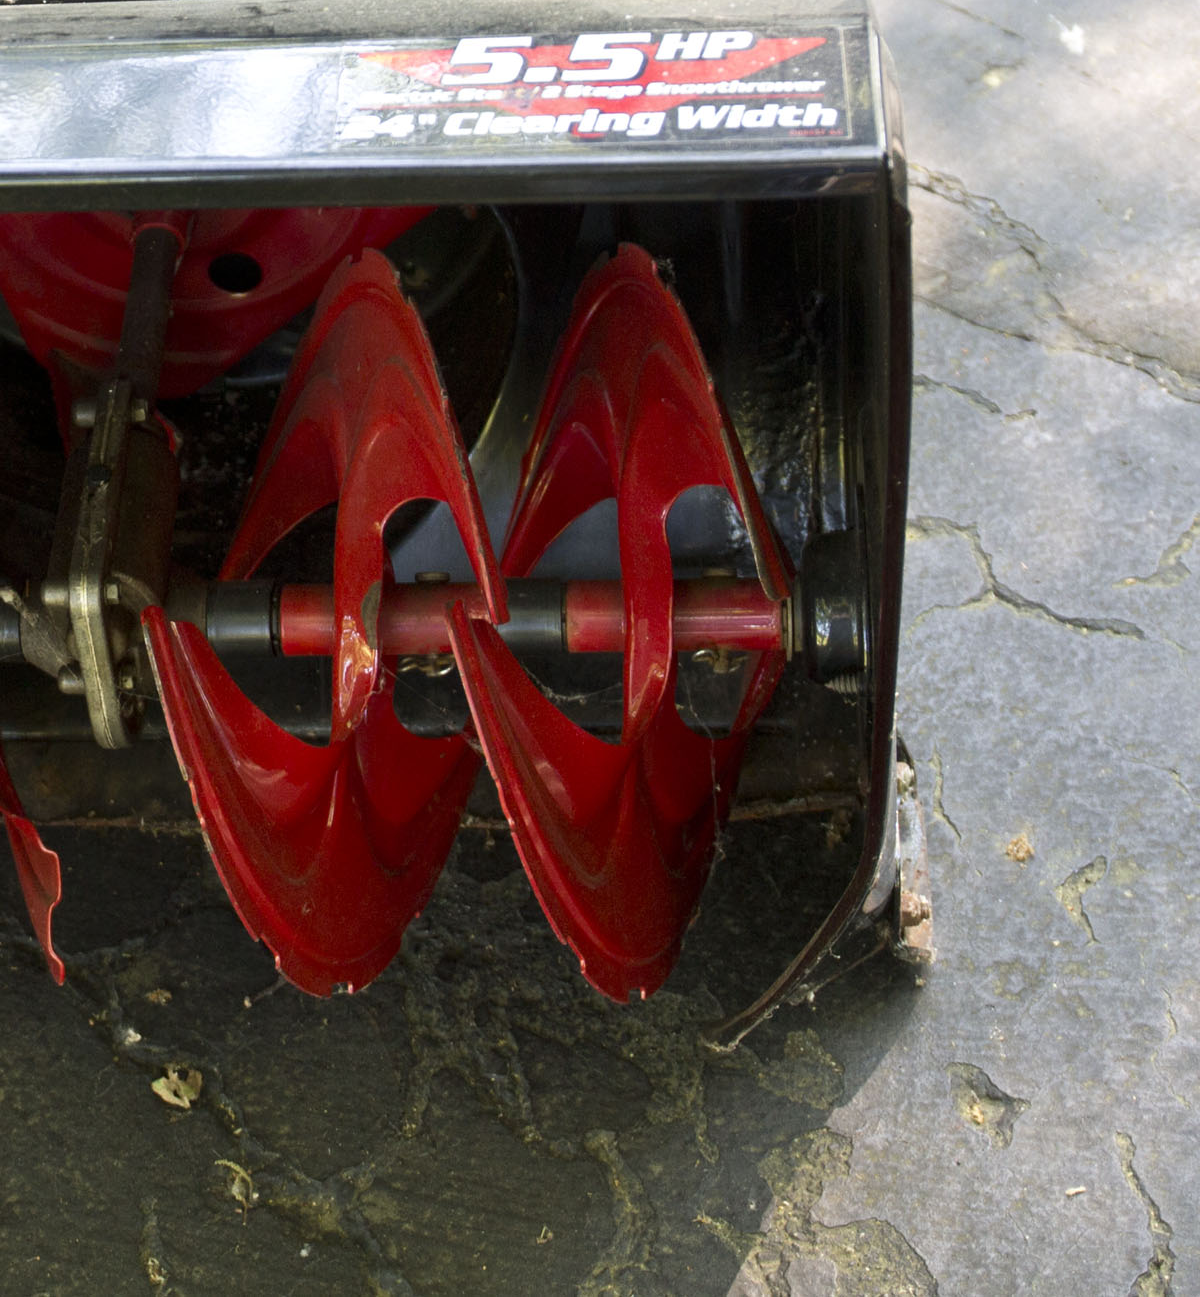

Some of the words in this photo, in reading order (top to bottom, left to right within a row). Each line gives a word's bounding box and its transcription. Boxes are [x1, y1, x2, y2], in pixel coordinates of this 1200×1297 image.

[441, 33, 651, 84] 5.5
[655, 31, 755, 61] HP
[564, 84, 643, 100] Stage
[645, 79, 827, 96] Snowthrower
[443, 108, 667, 137] Clearing
[677, 102, 838, 130] Width
